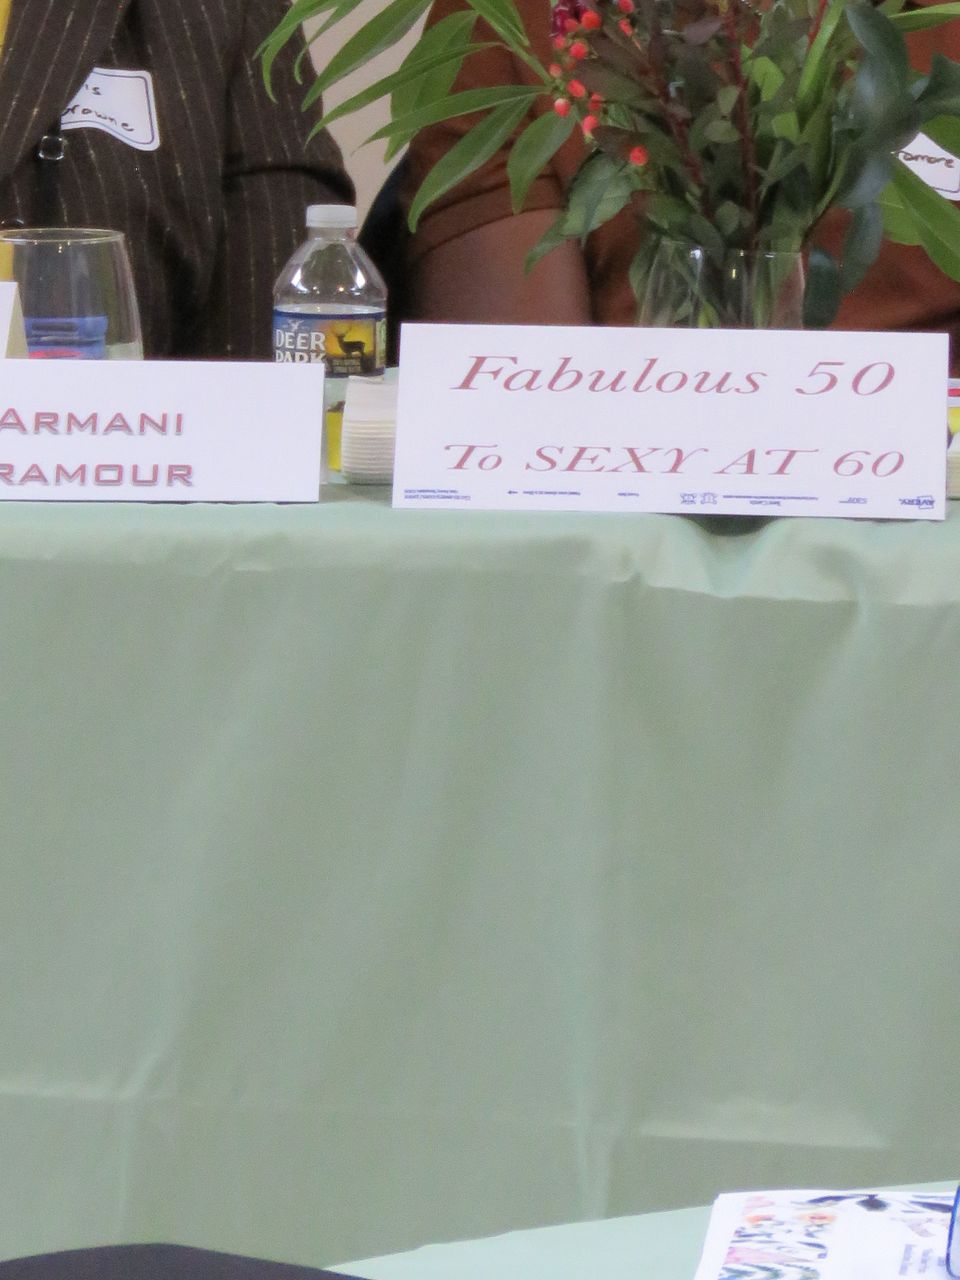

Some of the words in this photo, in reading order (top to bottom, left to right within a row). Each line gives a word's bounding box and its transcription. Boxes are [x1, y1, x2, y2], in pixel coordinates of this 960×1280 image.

[275, 329, 326, 351] DEER
[449, 355, 768, 394] Fabulous
[795, 361, 896, 396] 50
[525, 445, 709, 474] SEXY
[712, 448, 820, 475] AT
[833, 450, 904, 477] 60
